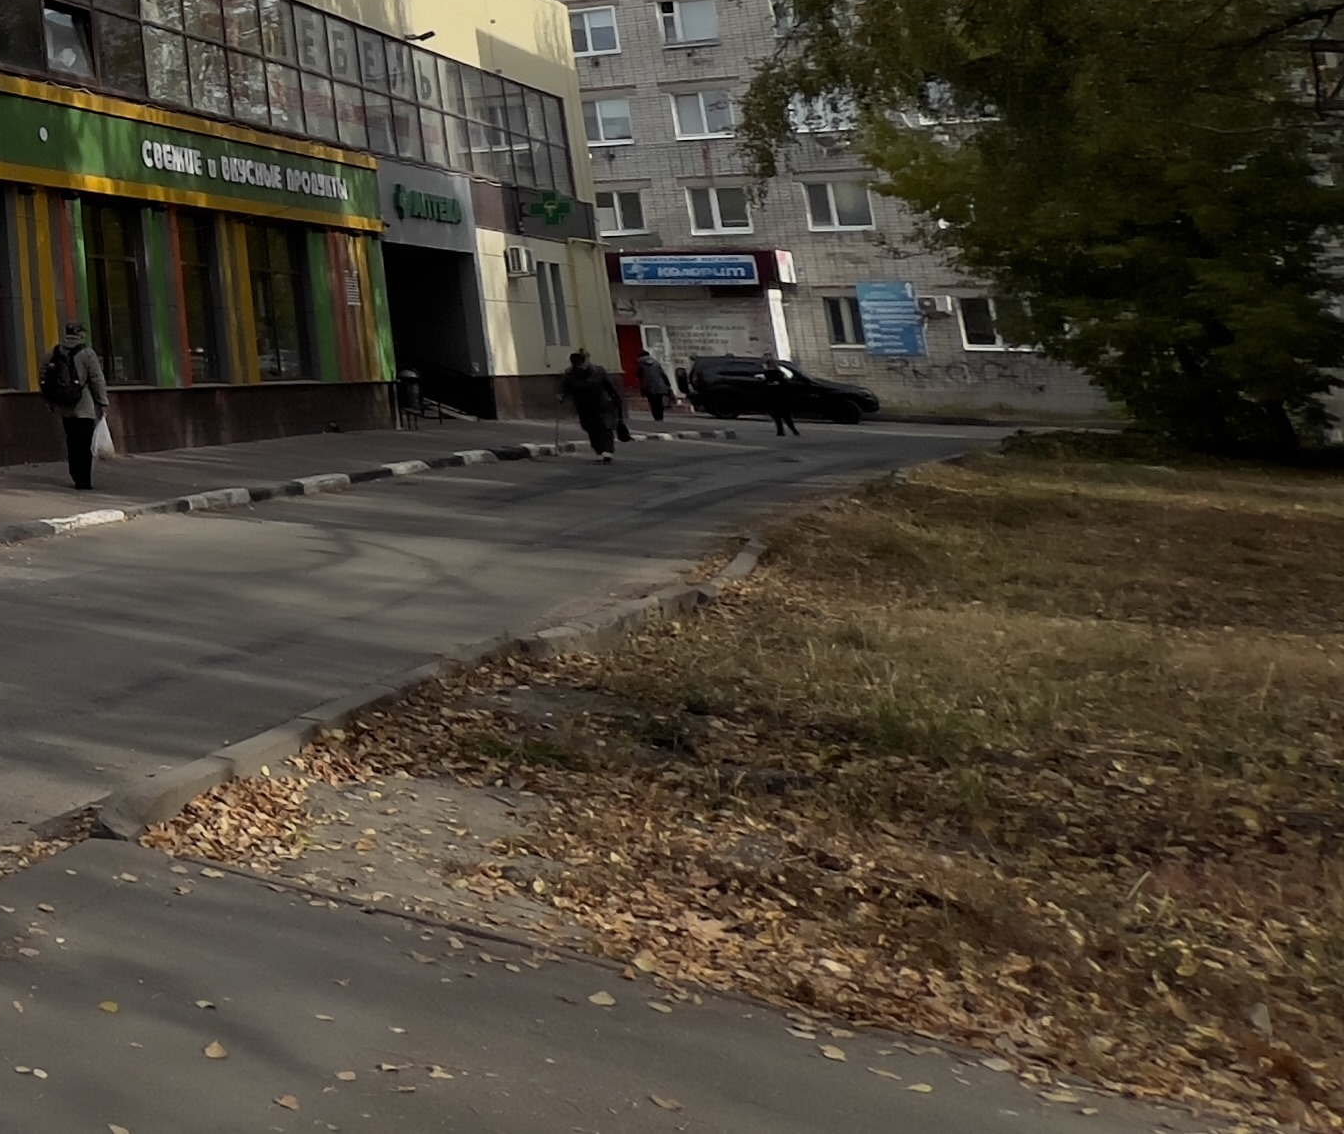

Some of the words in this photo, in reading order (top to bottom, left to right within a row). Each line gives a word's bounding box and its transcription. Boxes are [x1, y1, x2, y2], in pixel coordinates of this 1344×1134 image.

[142, 139, 203, 176] СВЕЖИЕ
[220, 155, 282, 189] ВКУСНЫЕ
[286, 168, 348, 200] ПРОДУКТЫ
